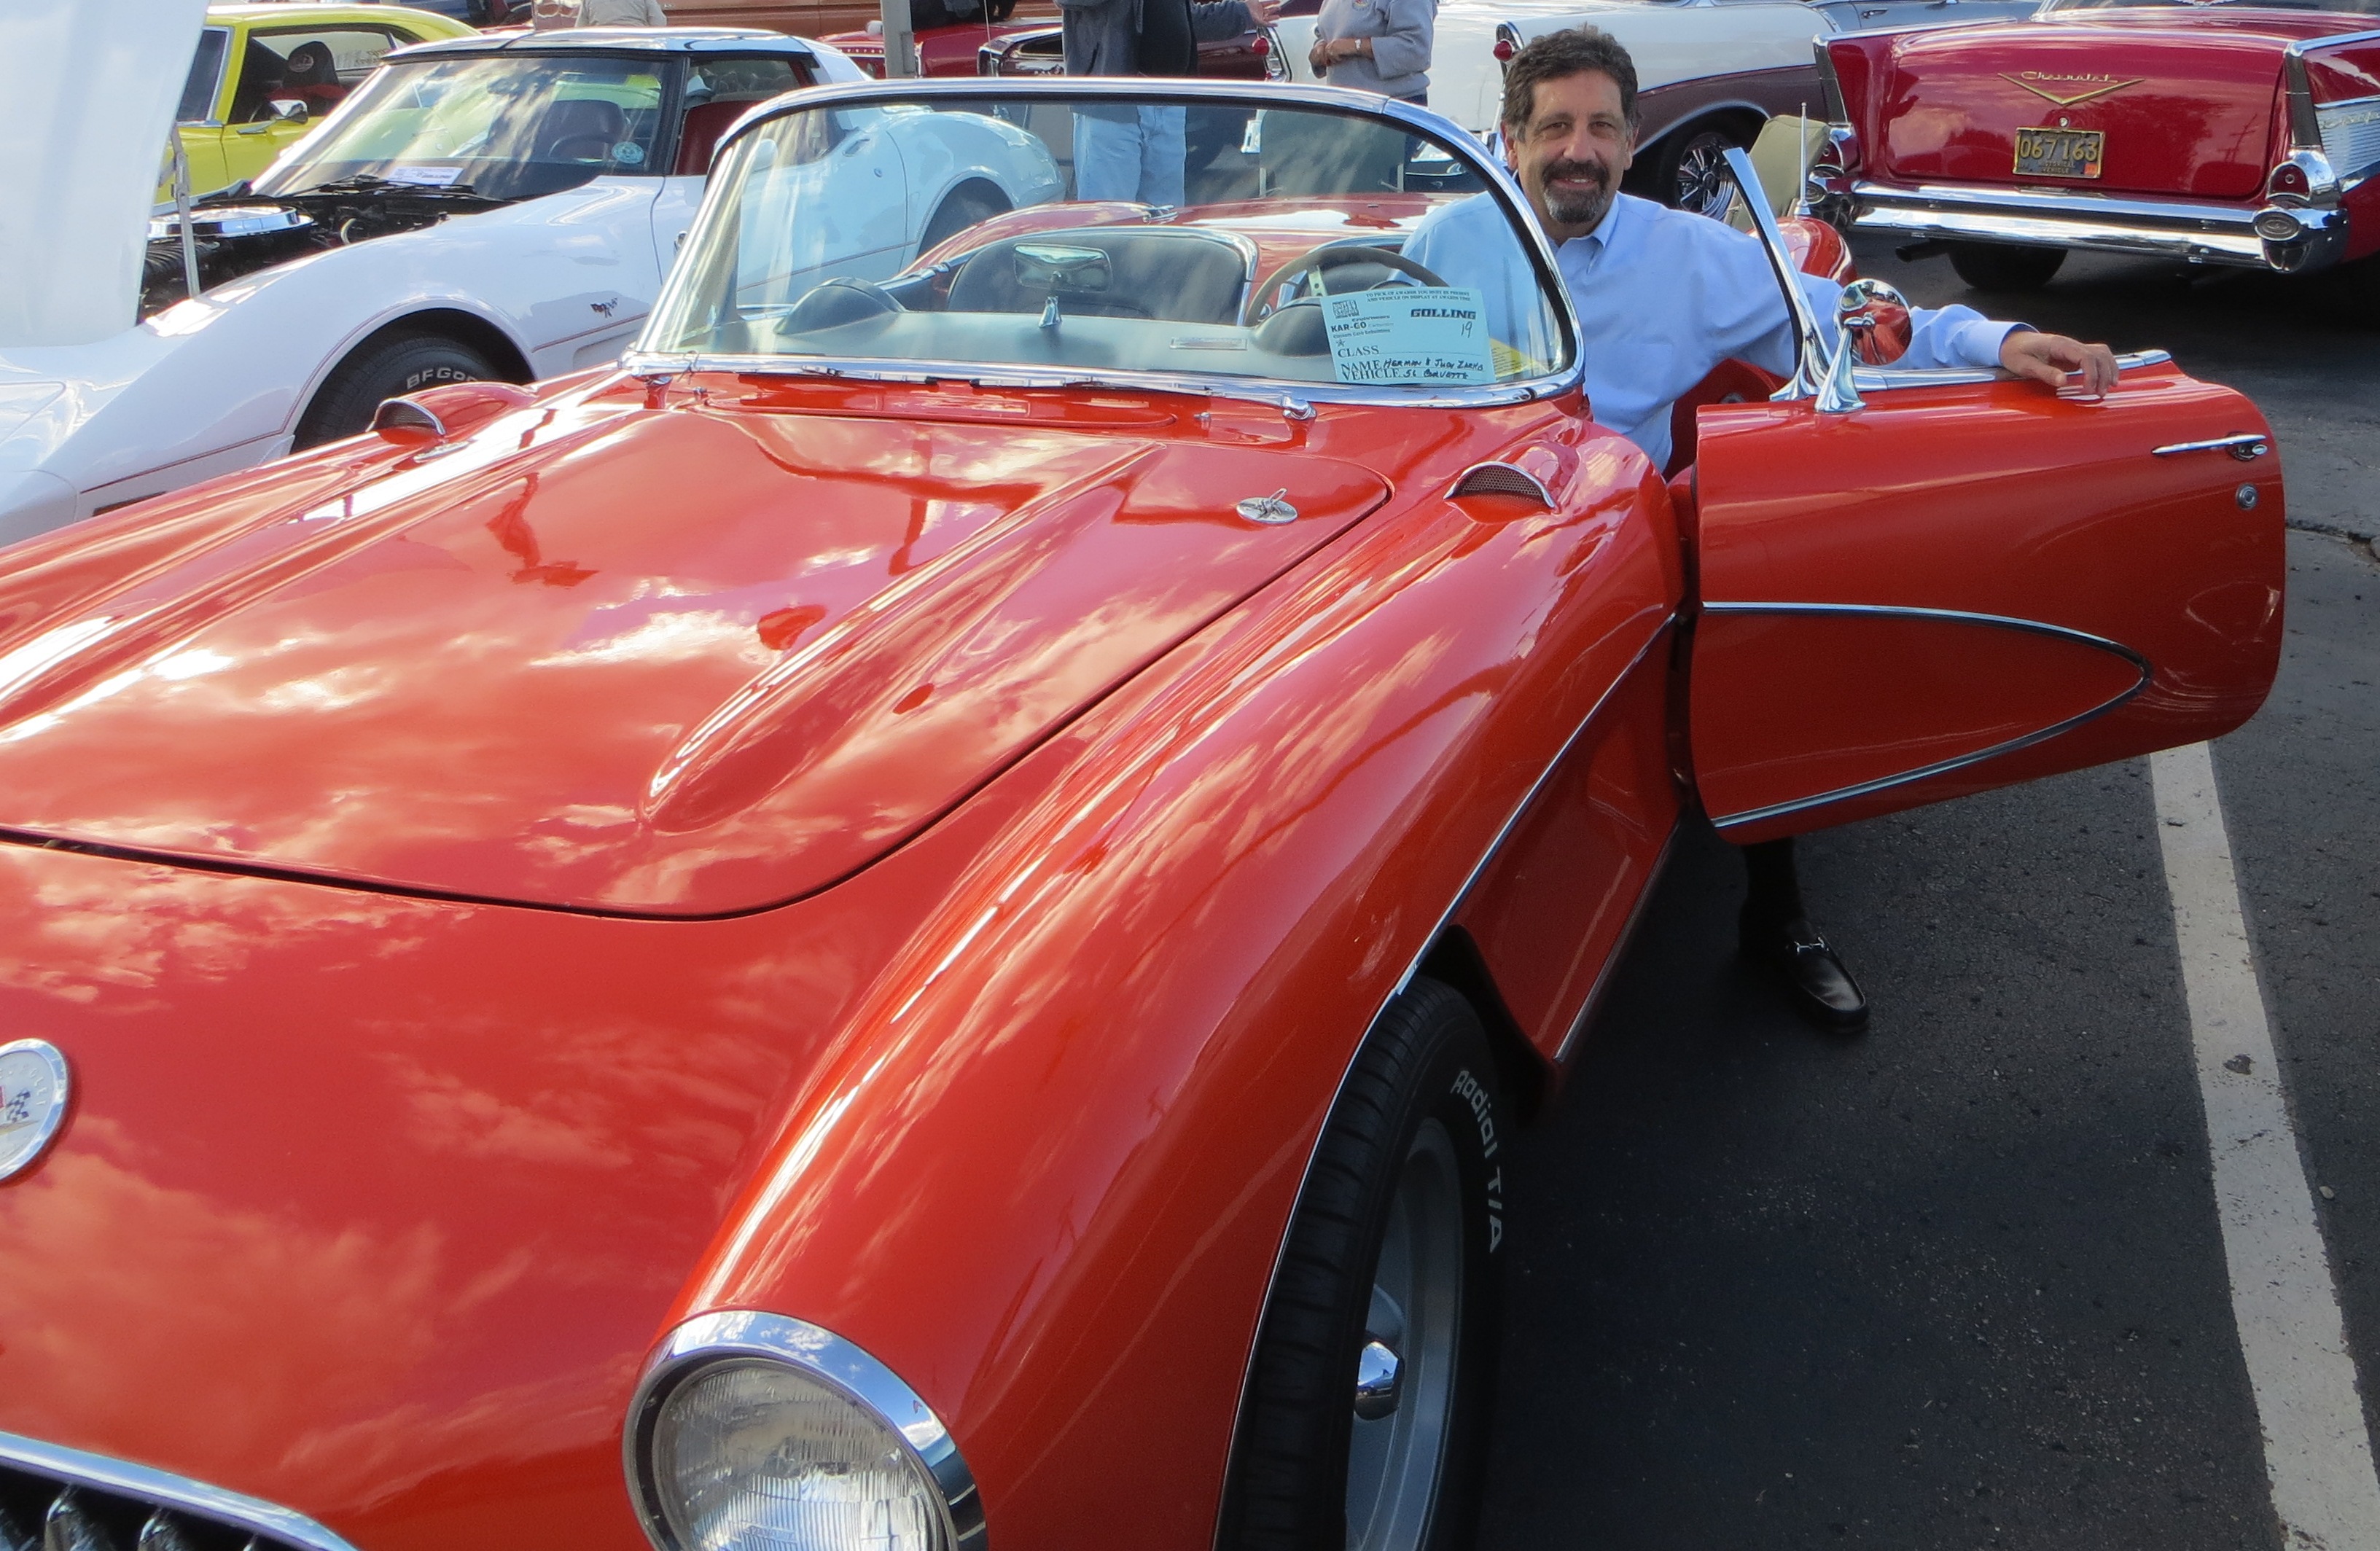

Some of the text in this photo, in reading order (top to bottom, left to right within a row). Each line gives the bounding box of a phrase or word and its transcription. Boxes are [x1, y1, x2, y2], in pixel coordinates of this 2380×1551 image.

[2021, 71, 2118, 83] Chevrolet
[1411, 308, 1476, 320] GOLLING
[1330, 321, 1367, 332] KAR-GO
[1461, 321, 1472, 338] 19
[1338, 345, 1379, 358] CLASS
[1341, 360, 1382, 372] NAME
[1341, 367, 1400, 381] VEHICLE
[1488, 1165, 1503, 1254] T/A
